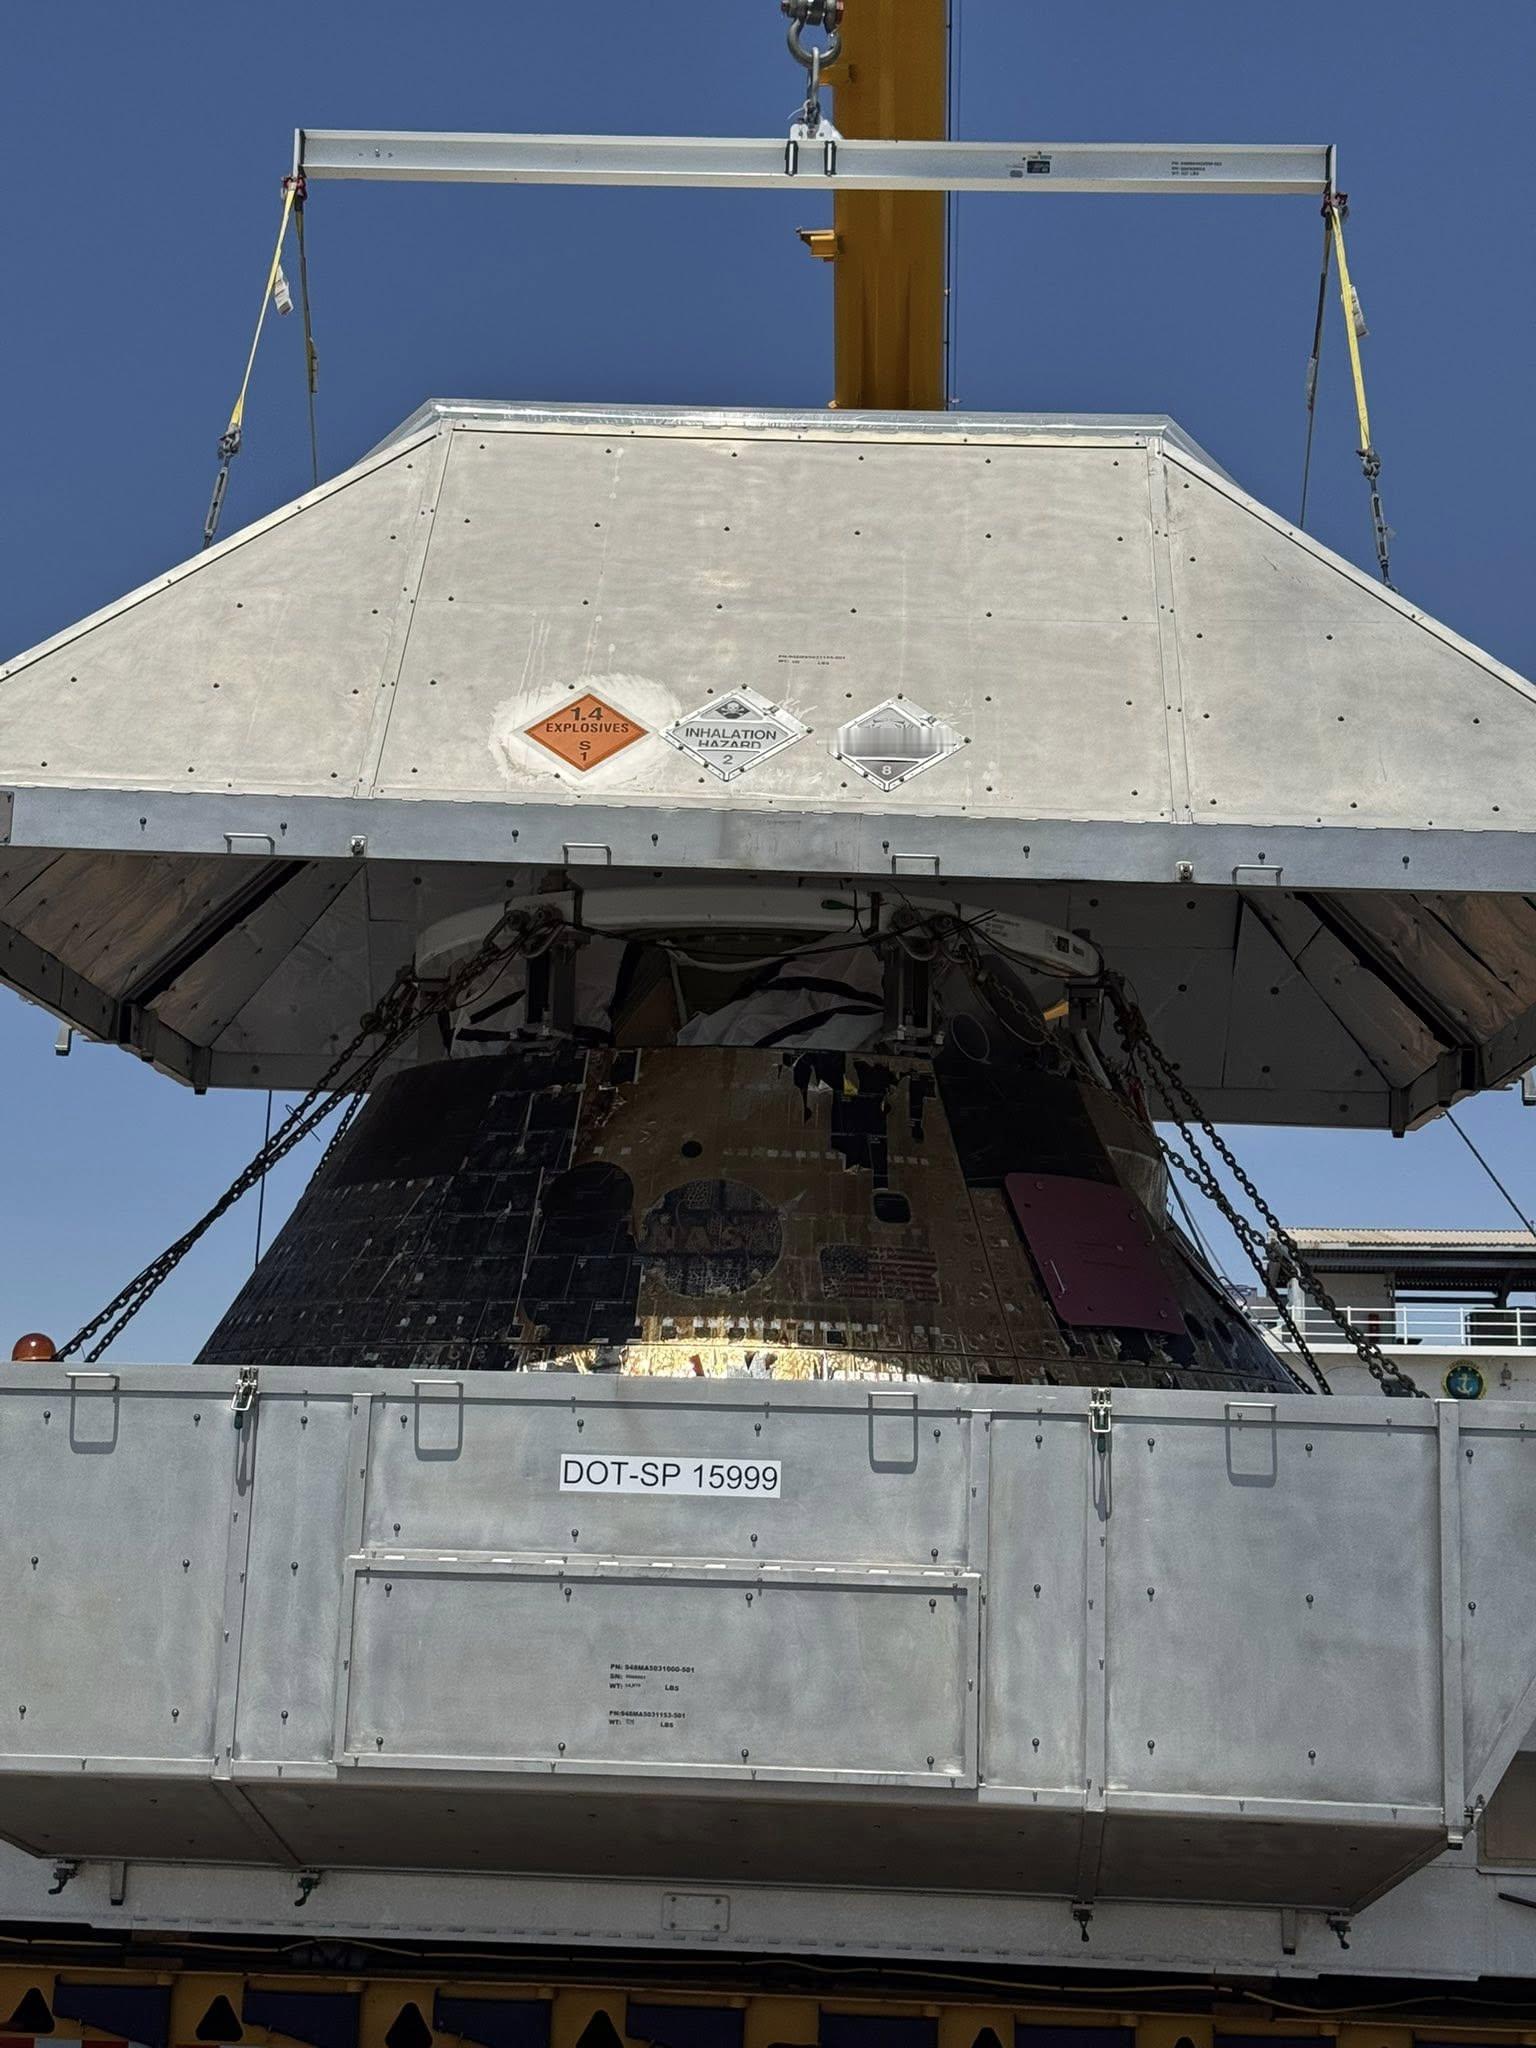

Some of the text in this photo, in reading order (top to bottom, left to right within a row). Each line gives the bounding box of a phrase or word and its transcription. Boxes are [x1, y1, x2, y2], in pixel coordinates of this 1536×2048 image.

[570, 706, 604, 721] 1.4
[545, 722, 629, 734] EXPLOSIVES
[685, 727, 777, 740] INHALATION
[578, 740, 592, 751] S
[698, 740, 761, 749] HAZARD
[579, 751, 588, 761] 1
[722, 754, 734, 765] 2
[881, 765, 892, 775] 8
[563, 1459, 779, 1491] DOT-SP 15999
